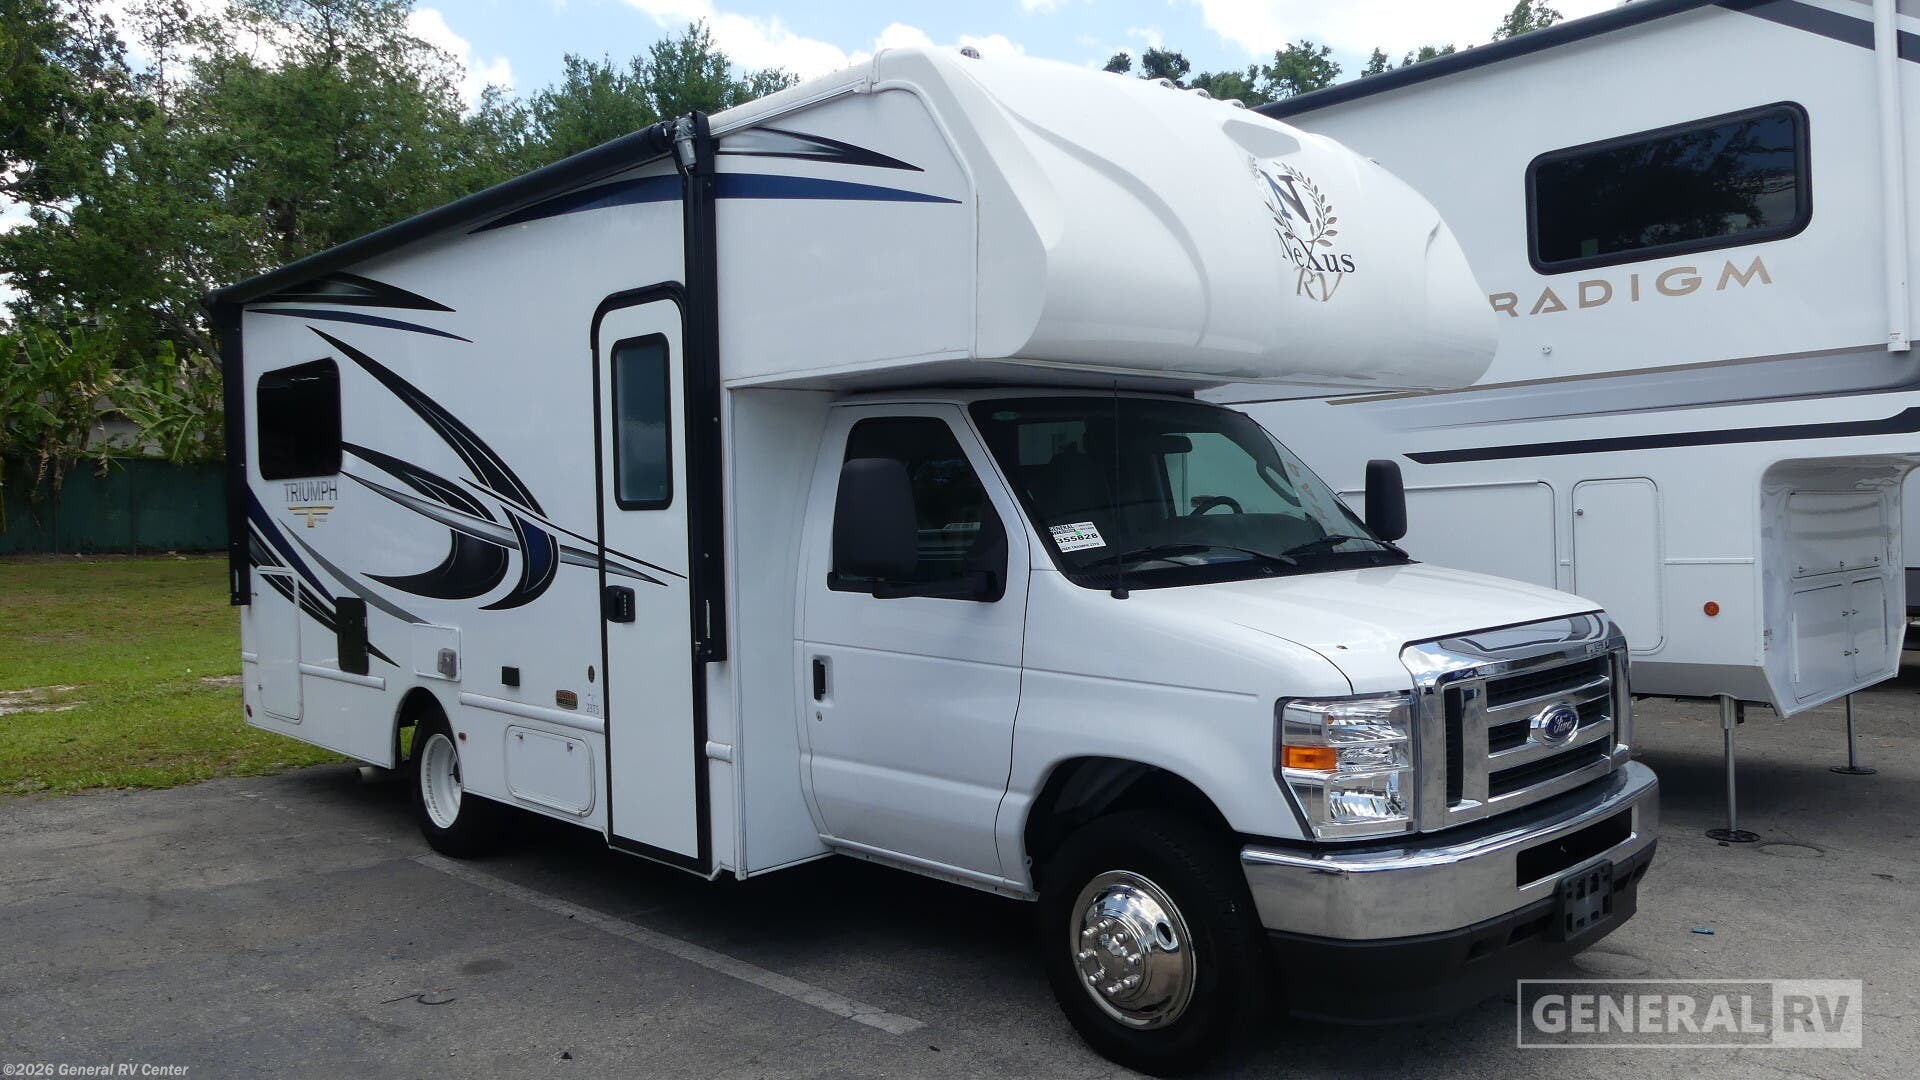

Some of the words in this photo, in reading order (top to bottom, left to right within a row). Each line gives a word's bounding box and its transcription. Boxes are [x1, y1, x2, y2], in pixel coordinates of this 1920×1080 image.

[1294, 266, 1343, 302] RV
[283, 480, 339, 502] TRIUMPH
[1056, 533, 1098, 544] 355828
[1553, 714, 1574, 735] Ford
